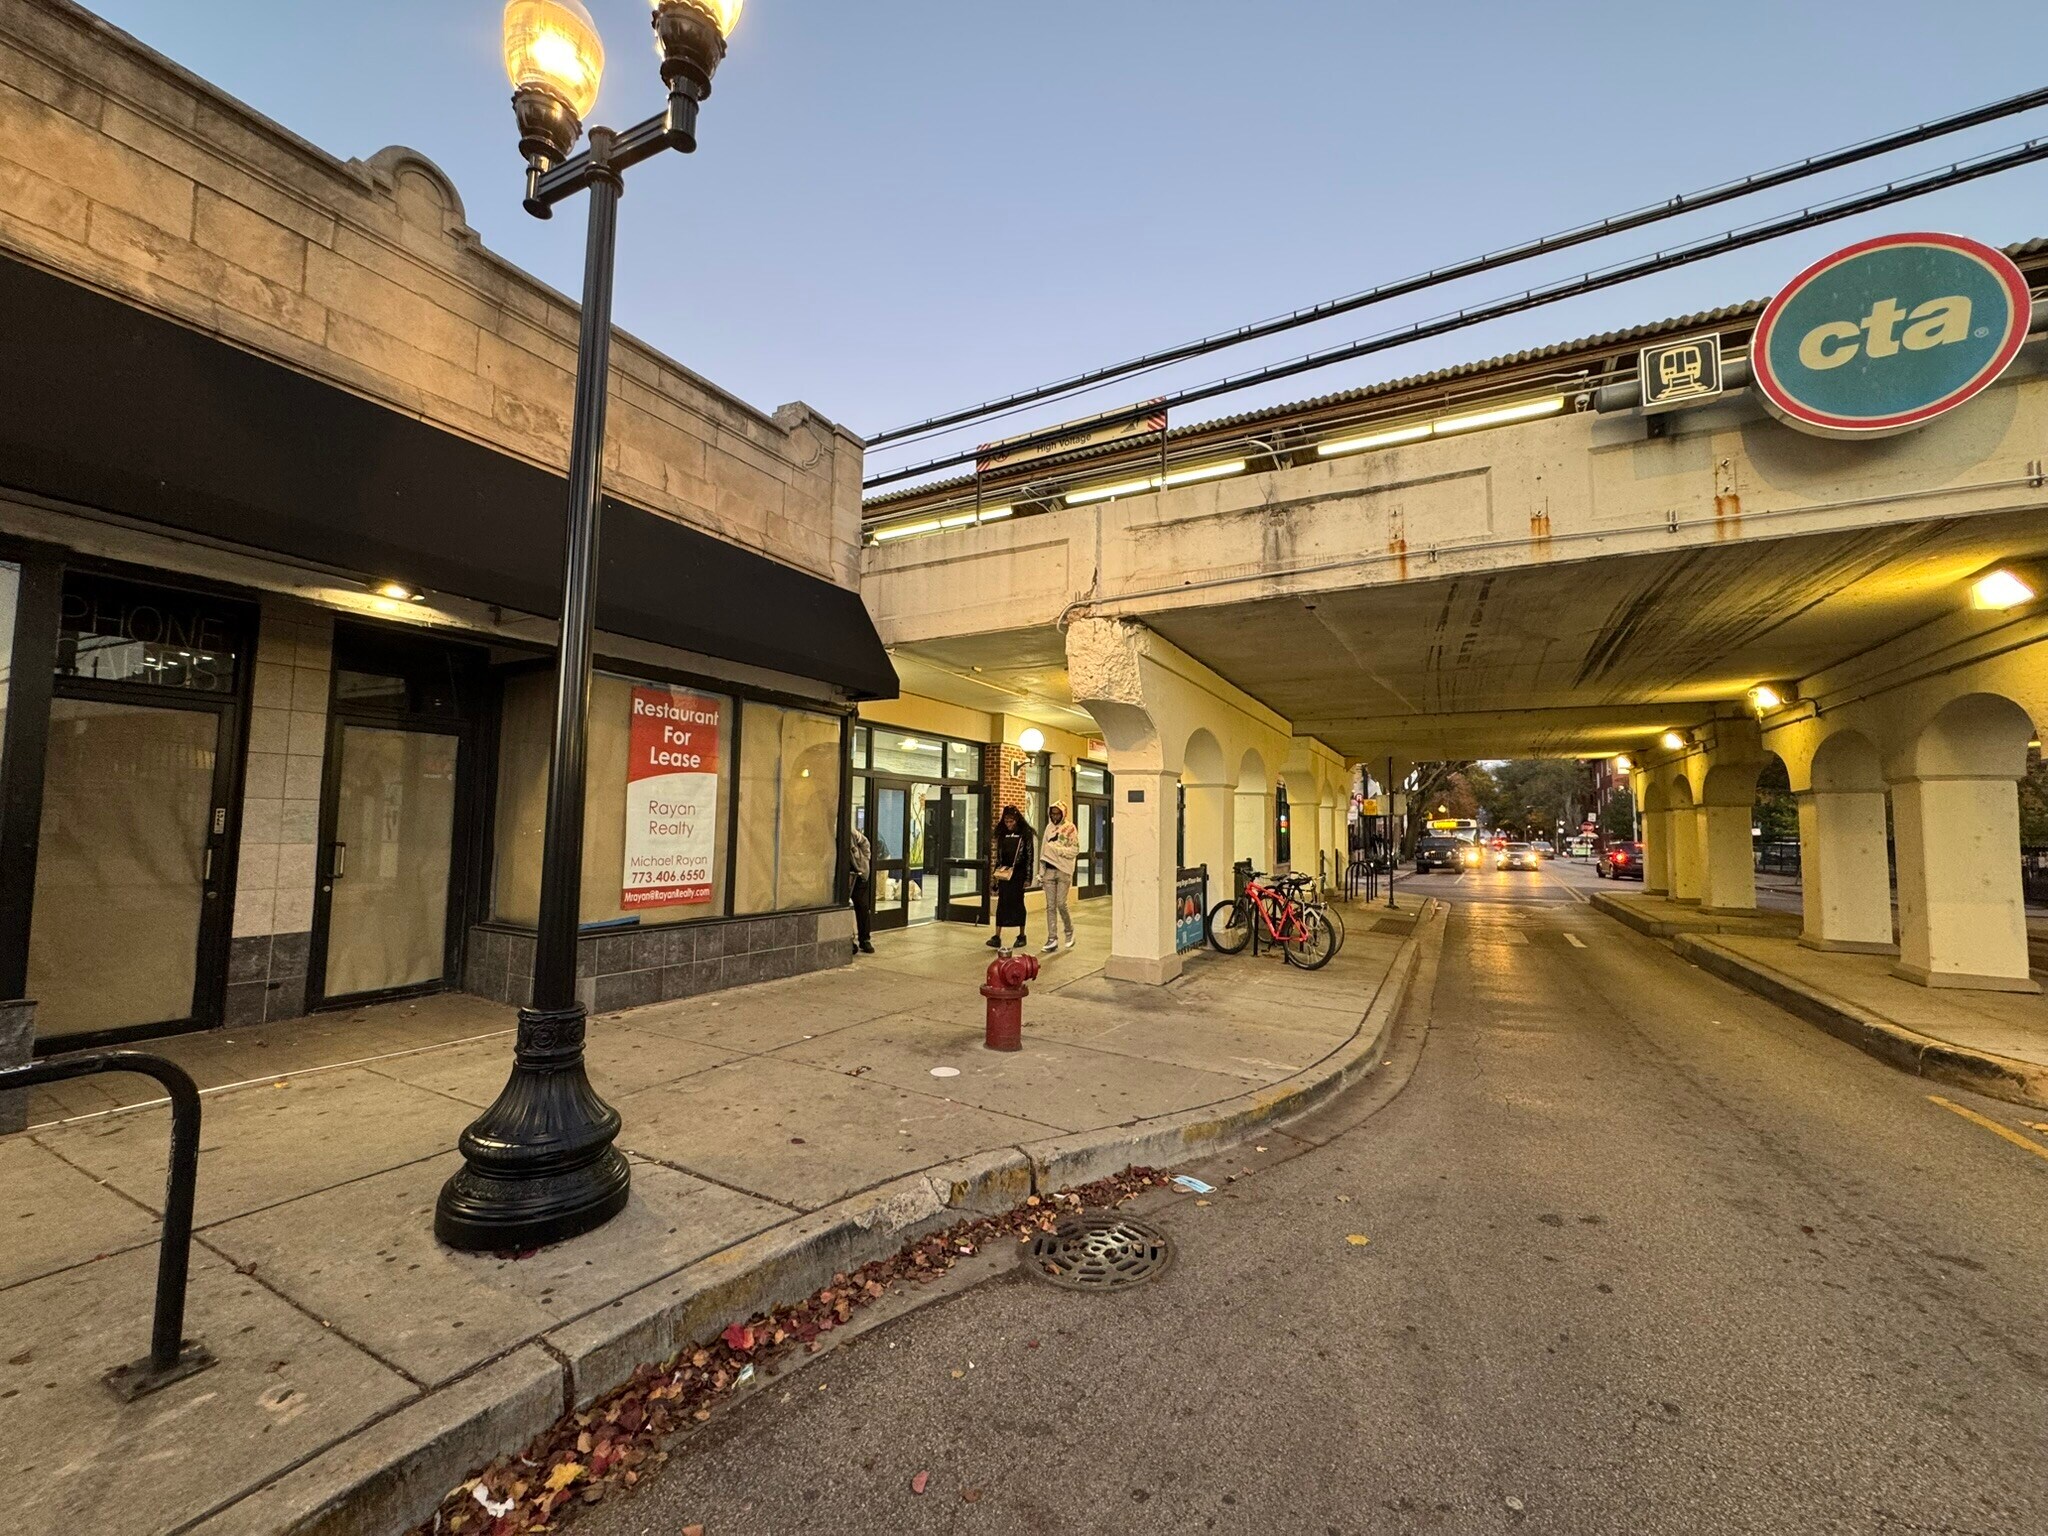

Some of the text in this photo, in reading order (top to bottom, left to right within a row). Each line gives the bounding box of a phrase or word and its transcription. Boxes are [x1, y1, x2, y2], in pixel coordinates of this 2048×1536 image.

[1799, 296, 1972, 370] cta
[1037, 434, 1092, 453] High Voltage
[61, 594, 226, 654] PHONE
[634, 698, 719, 725] Restaurant
[664, 725, 692, 745] For
[650, 746, 701, 768] Lease
[648, 800, 696, 818] Rayan
[649, 820, 694, 837] Realty
[630, 855, 708, 867] Michael Rayan
[632, 869, 705, 883] 773.406.6550
[624, 888, 710, 903] Mrayan@RayanRealty.com
